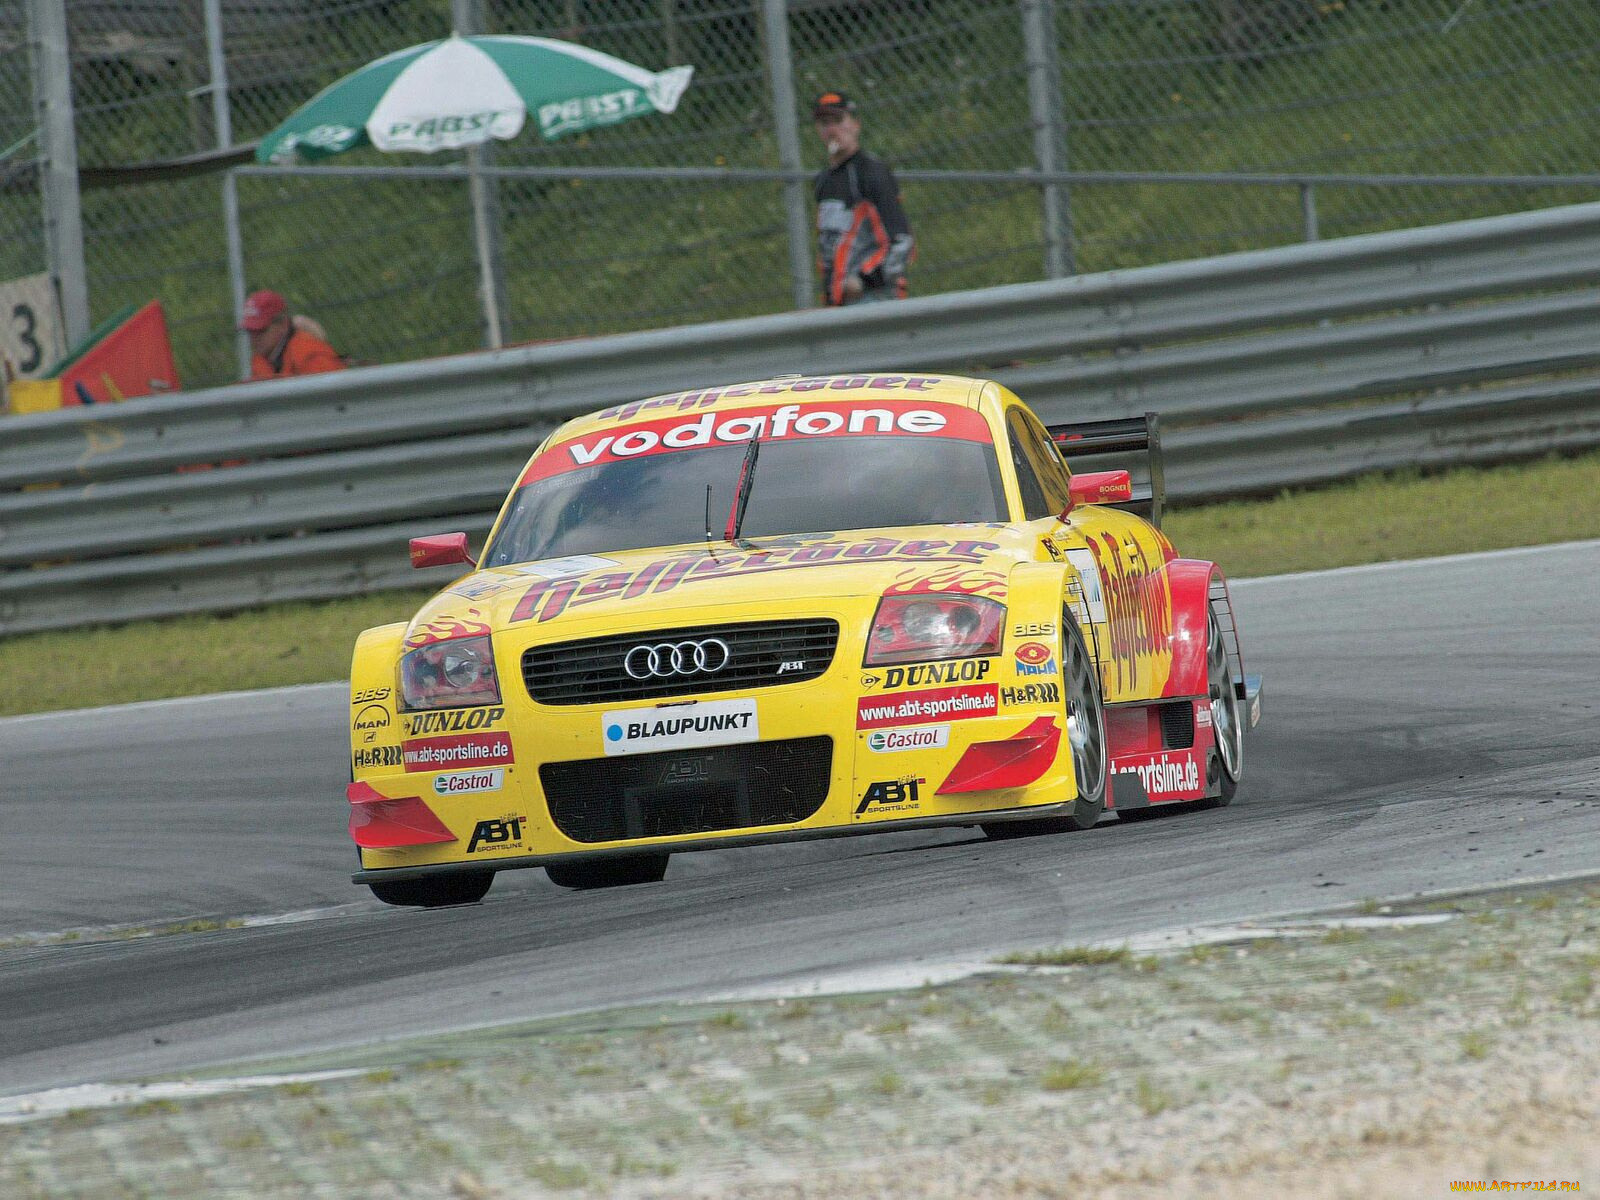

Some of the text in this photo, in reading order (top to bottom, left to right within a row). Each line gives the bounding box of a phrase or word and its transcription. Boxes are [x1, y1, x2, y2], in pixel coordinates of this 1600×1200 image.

[538, 90, 640, 128] PABST
[390, 111, 502, 137] PABST
[13, 303, 41, 373] 3
[569, 405, 947, 465] vodafone
[1099, 484, 1126, 493] BOGNER
[1013, 622, 1055, 637] BBS
[776, 660, 805, 674] ABT
[883, 660, 989, 689] DUNLOP
[352, 687, 391, 704] BBS
[1001, 684, 1037, 705] H&R
[859, 692, 996, 721] www.abt-sportsline.de
[356, 719, 387, 730] MAN
[411, 708, 505, 736] DUNLOP
[627, 712, 753, 739] BLAUPUNKT
[887, 729, 938, 748] Castrol
[355, 747, 383, 767] H&R
[404, 741, 508, 764] www.abt-sportsline.de
[448, 773, 493, 791] Castrol
[855, 779, 918, 813] ABT
[868, 803, 920, 813] SPORTSLINE
[467, 817, 521, 853] ABT
[477, 842, 522, 852] SPORTSLINE
